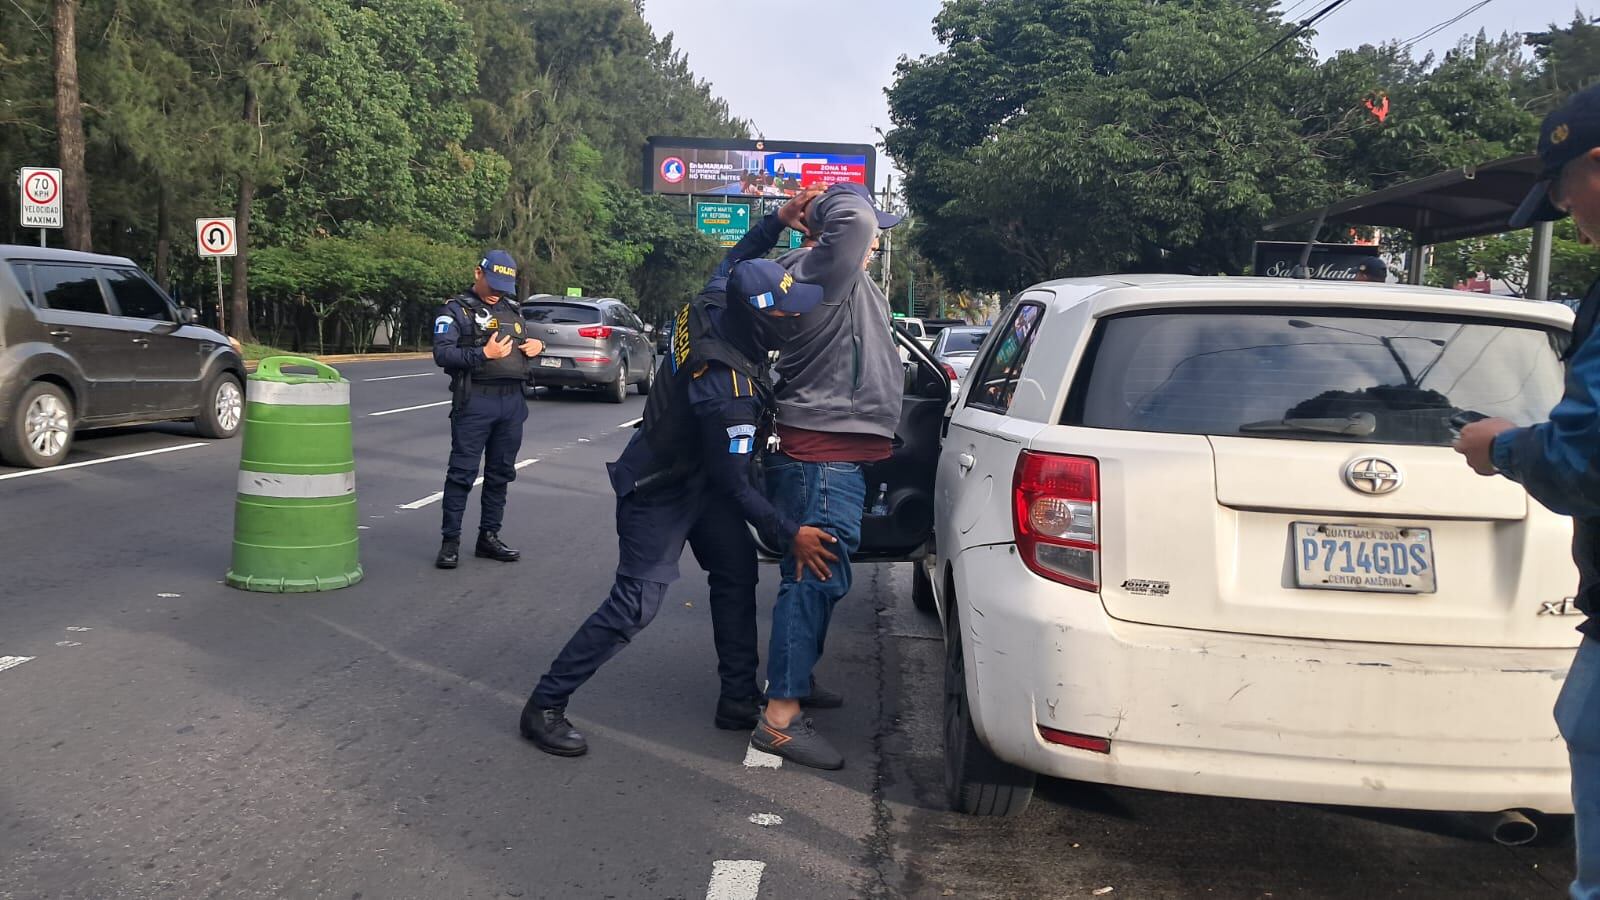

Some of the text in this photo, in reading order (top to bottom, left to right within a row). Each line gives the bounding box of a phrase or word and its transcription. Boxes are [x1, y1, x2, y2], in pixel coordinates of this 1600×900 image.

[34, 178, 49, 190] 70
[25, 205, 59, 214] VELOCIDAD
[26, 216, 58, 225] MAXIMA
[1325, 528, 1377, 540] GUATEMALA
[1302, 538, 1428, 576] P714GDS
[1120, 580, 1150, 588] JOHN
[1328, 575, 1362, 585] CENTRO
